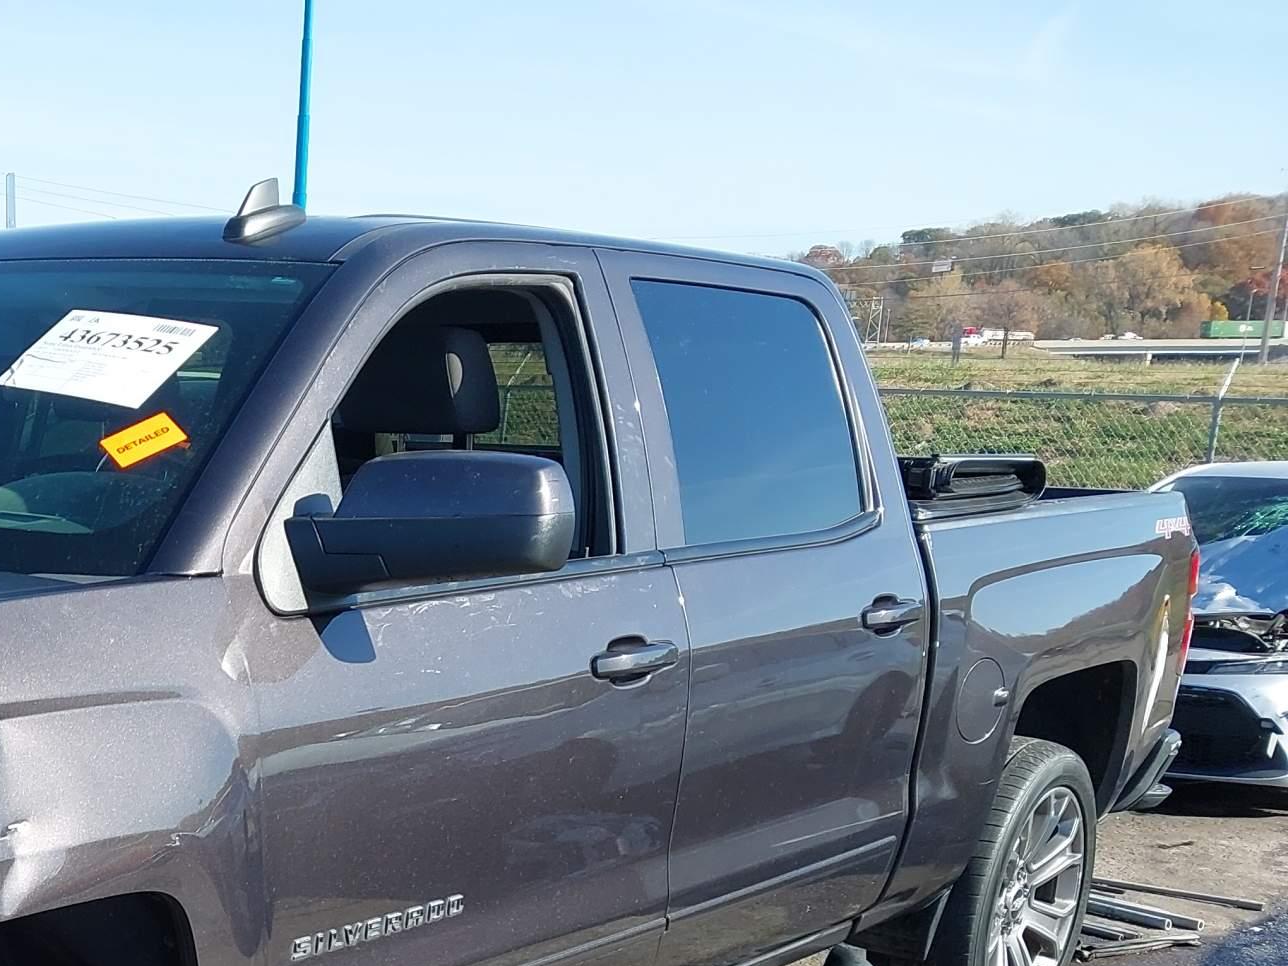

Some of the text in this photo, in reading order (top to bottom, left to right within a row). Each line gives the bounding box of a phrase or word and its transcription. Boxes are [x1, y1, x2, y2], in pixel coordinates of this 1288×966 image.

[59, 328, 180, 355] 43673525
[116, 426, 170, 454] DETAILED
[291, 893, 465, 961] SILVERADO
